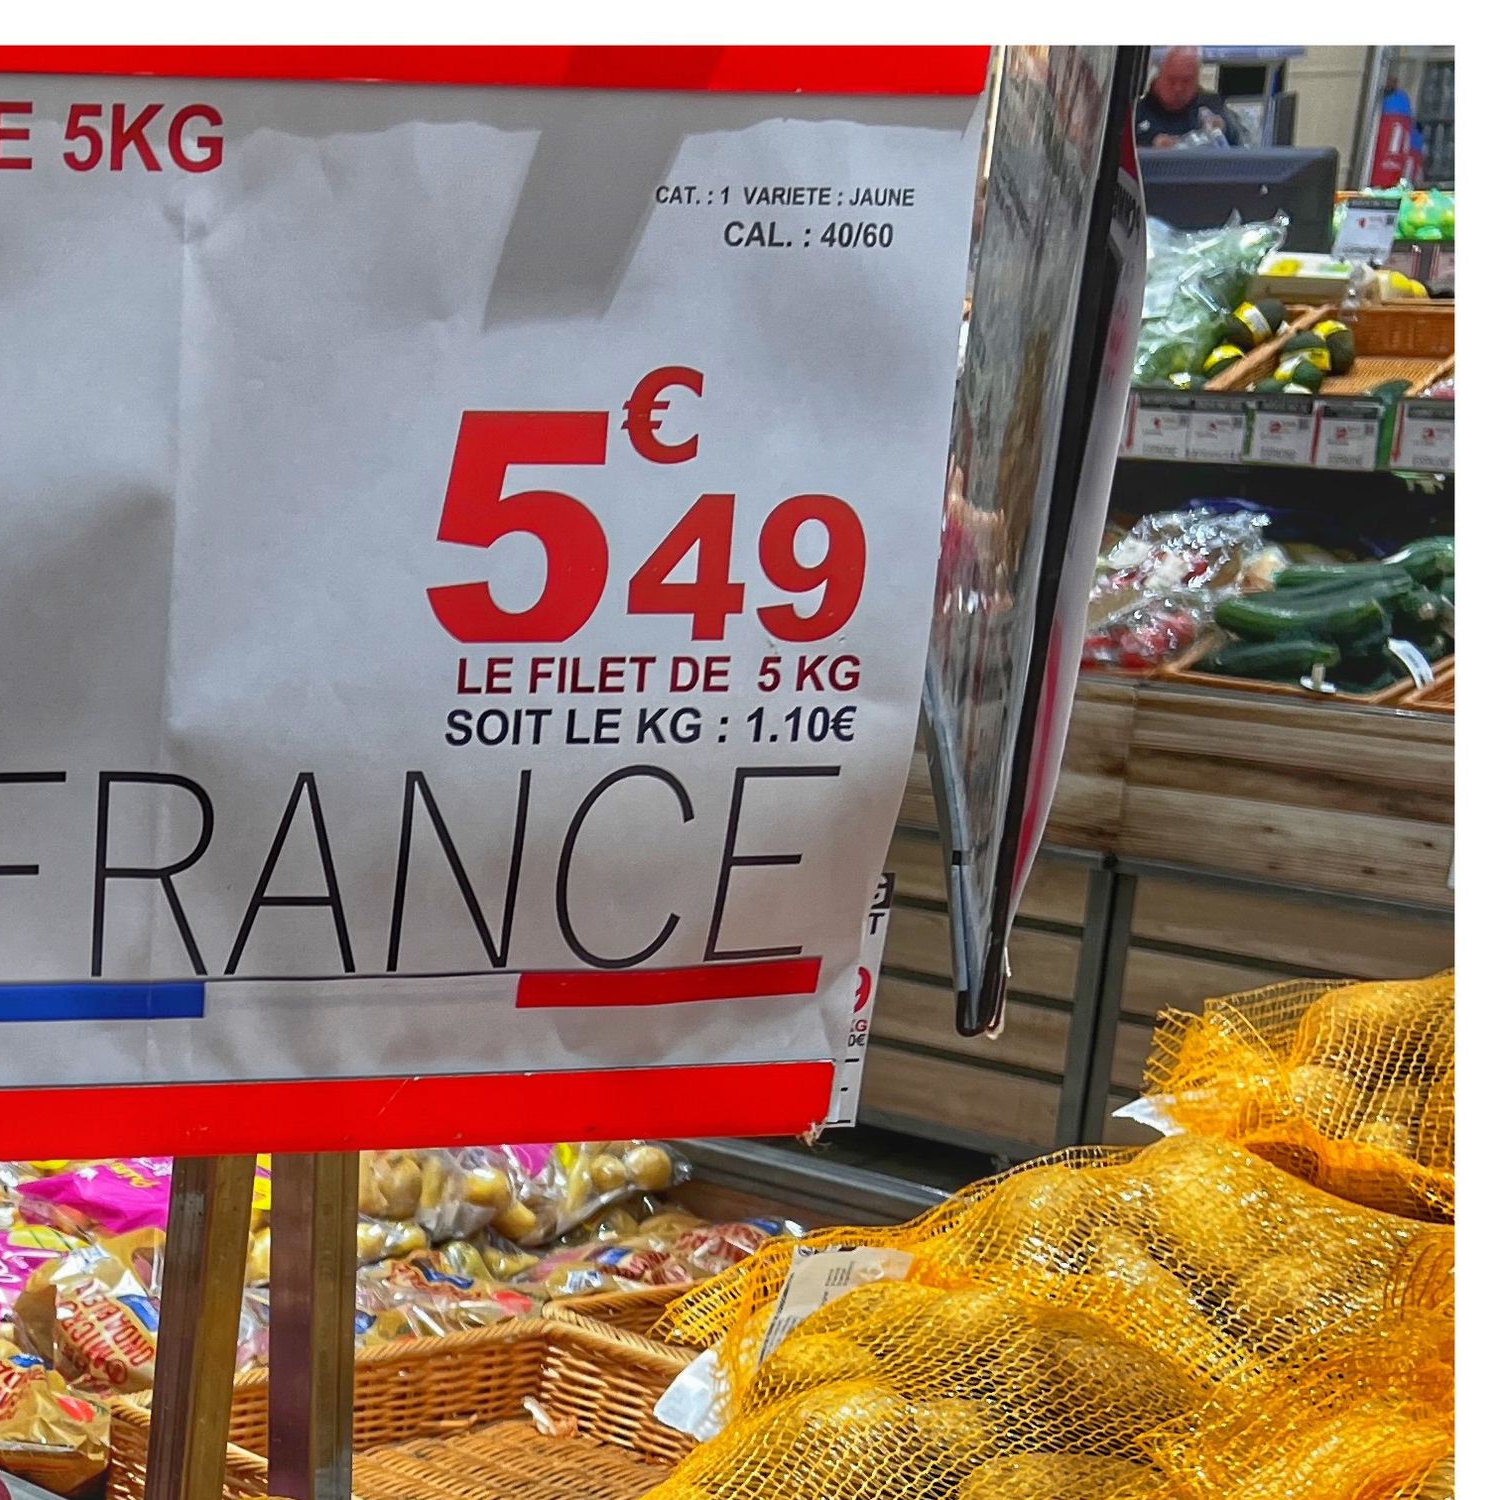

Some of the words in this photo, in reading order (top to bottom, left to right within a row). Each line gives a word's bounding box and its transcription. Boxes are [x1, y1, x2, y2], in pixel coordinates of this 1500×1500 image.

[62, 103, 225, 173] 5KG
[655, 185, 701, 205] CAT.
[743, 186, 832, 206] VARIETE
[849, 187, 916, 207] JAUNE
[723, 221, 793, 248] CAL.
[820, 221, 894, 249] 40/60
[457, 656, 514, 695] LE
[528, 656, 656, 694] FILET
[669, 655, 731, 693] DE
[757, 655, 782, 693] 5
[795, 654, 861, 693] KG
[445, 707, 553, 747] SOIT
[565, 707, 621, 745] LE
[635, 706, 704, 745] KG
[746, 704, 858, 744] 1.10€
